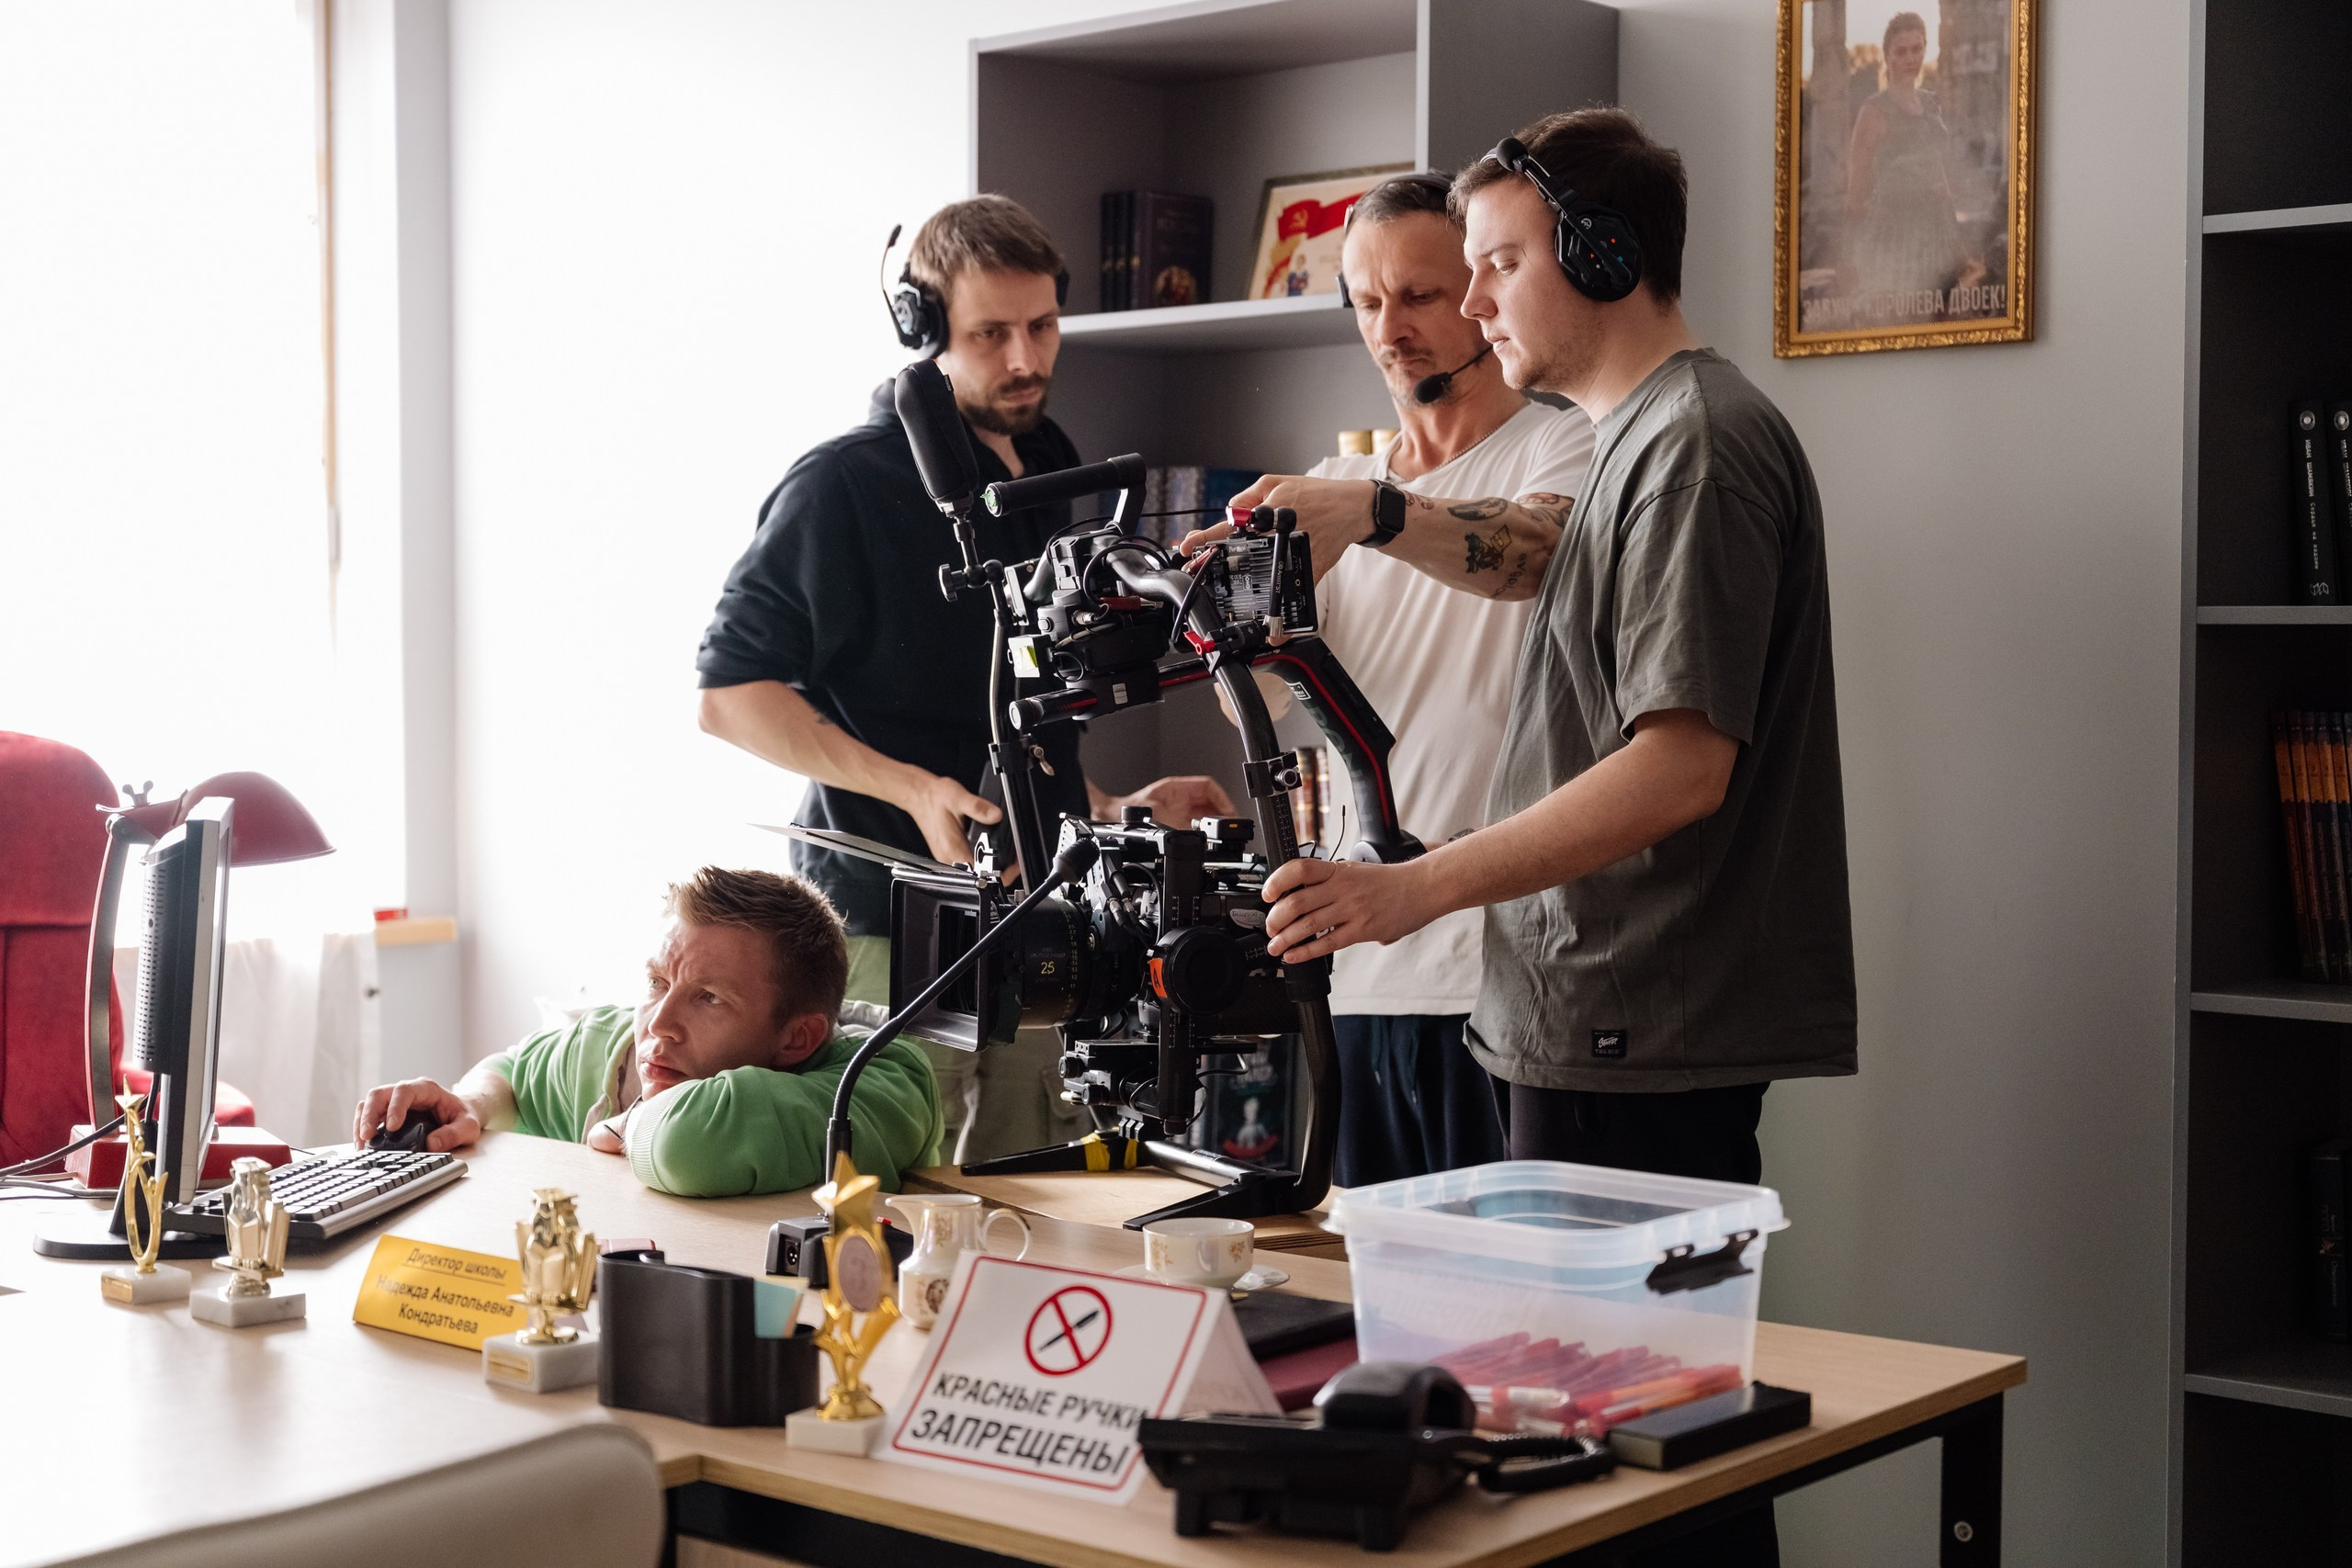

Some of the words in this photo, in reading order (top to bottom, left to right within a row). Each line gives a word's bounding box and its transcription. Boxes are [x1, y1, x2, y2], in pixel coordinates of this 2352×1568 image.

[1949, 285, 2006, 315] ДВОЕК!
[1040, 961, 1056, 975] 25
[407, 1248, 464, 1274] Директор
[465, 1262, 508, 1280] школы
[376, 1274, 429, 1301] Надежда
[431, 1286, 515, 1317] Анатольевна
[399, 1303, 479, 1335] Кондратьева
[933, 1372, 1057, 1416] КРАСНЫЕ
[1057, 1394, 1148, 1427] РУЧКИ
[911, 1408, 1130, 1474] ЗАПРЕЩЕНЫ
